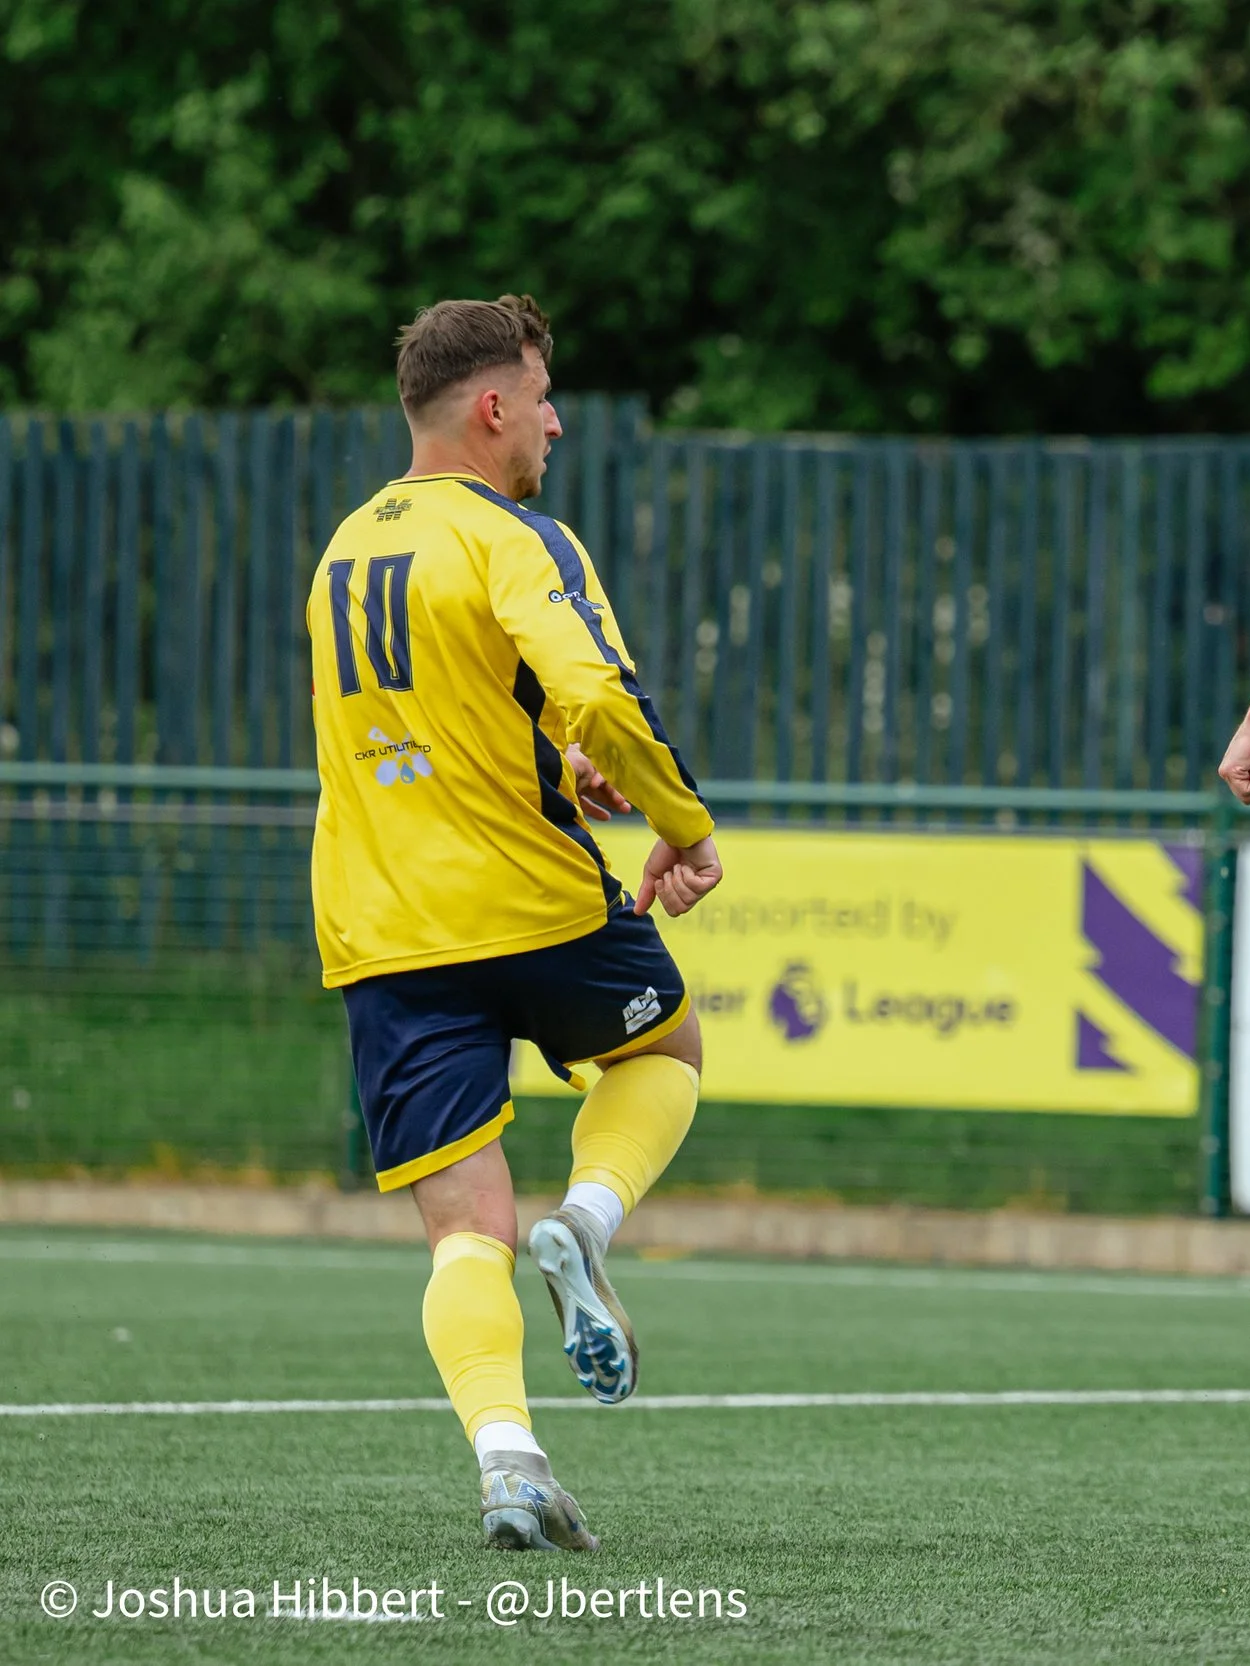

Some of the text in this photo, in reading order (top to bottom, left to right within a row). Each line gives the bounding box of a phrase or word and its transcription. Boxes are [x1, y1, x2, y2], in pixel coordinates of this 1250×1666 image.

[327, 551, 416, 698] 10
[355, 749, 376, 761] CKR
[664, 893, 958, 949] upported by
[842, 978, 1020, 1035] League
